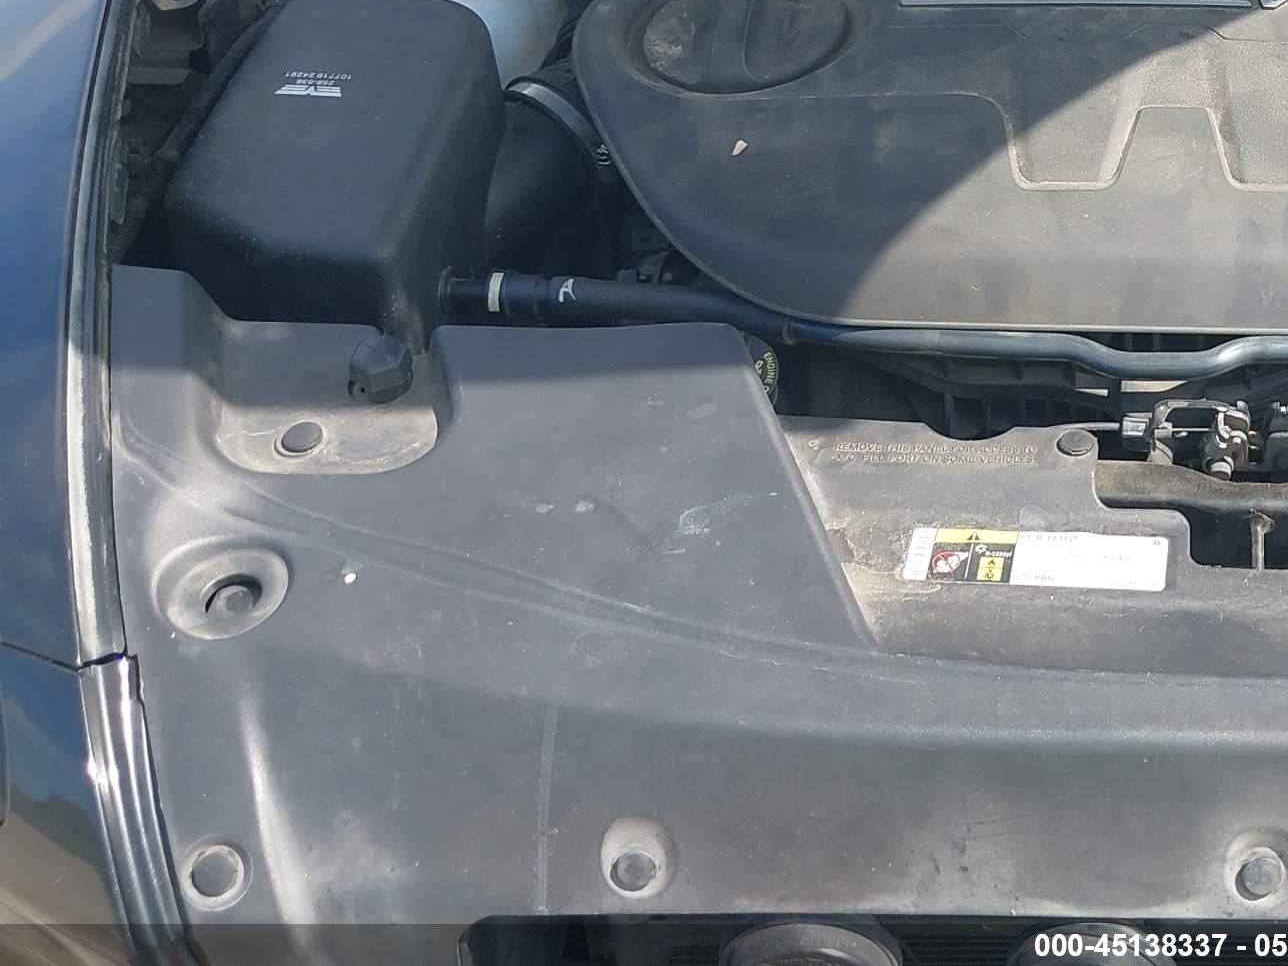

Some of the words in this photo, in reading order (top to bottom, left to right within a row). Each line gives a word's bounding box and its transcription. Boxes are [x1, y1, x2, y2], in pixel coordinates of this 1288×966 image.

[558, 278, 577, 303] A
[763, 351, 776, 385] ENGINE
[834, 441, 882, 452] REMOVE
[884, 442, 910, 453] THIS
[912, 443, 949, 454] PANEL
[951, 445, 974, 454] FOR
[976, 445, 1020, 455] ACCESS
[943, 454, 976, 464] SOME
[978, 454, 1034, 465] VEHICLES
